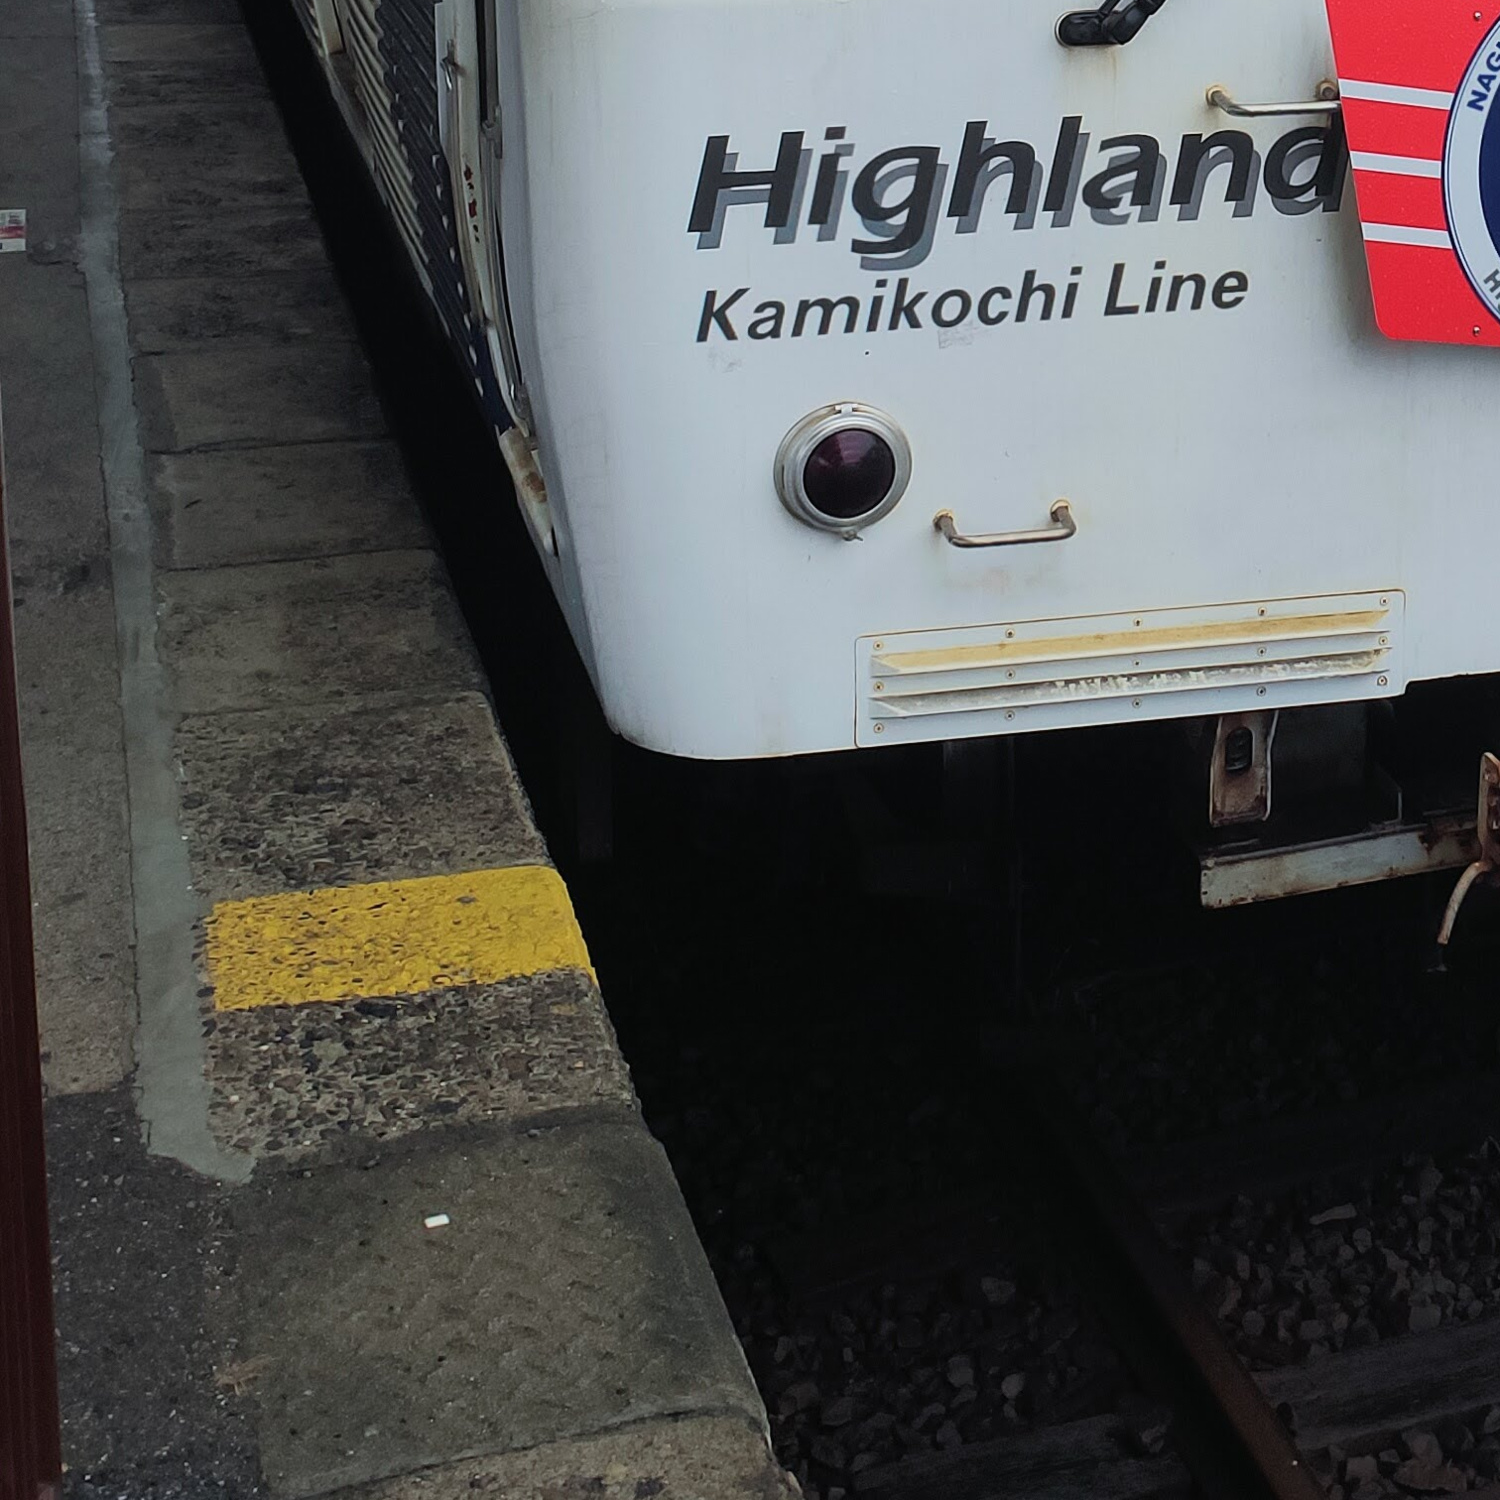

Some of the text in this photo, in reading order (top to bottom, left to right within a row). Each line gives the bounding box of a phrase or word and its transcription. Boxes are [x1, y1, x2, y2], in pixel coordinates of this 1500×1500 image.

[687, 106, 1348, 271] Highland
[695, 259, 1250, 344] Kamikochi Line
